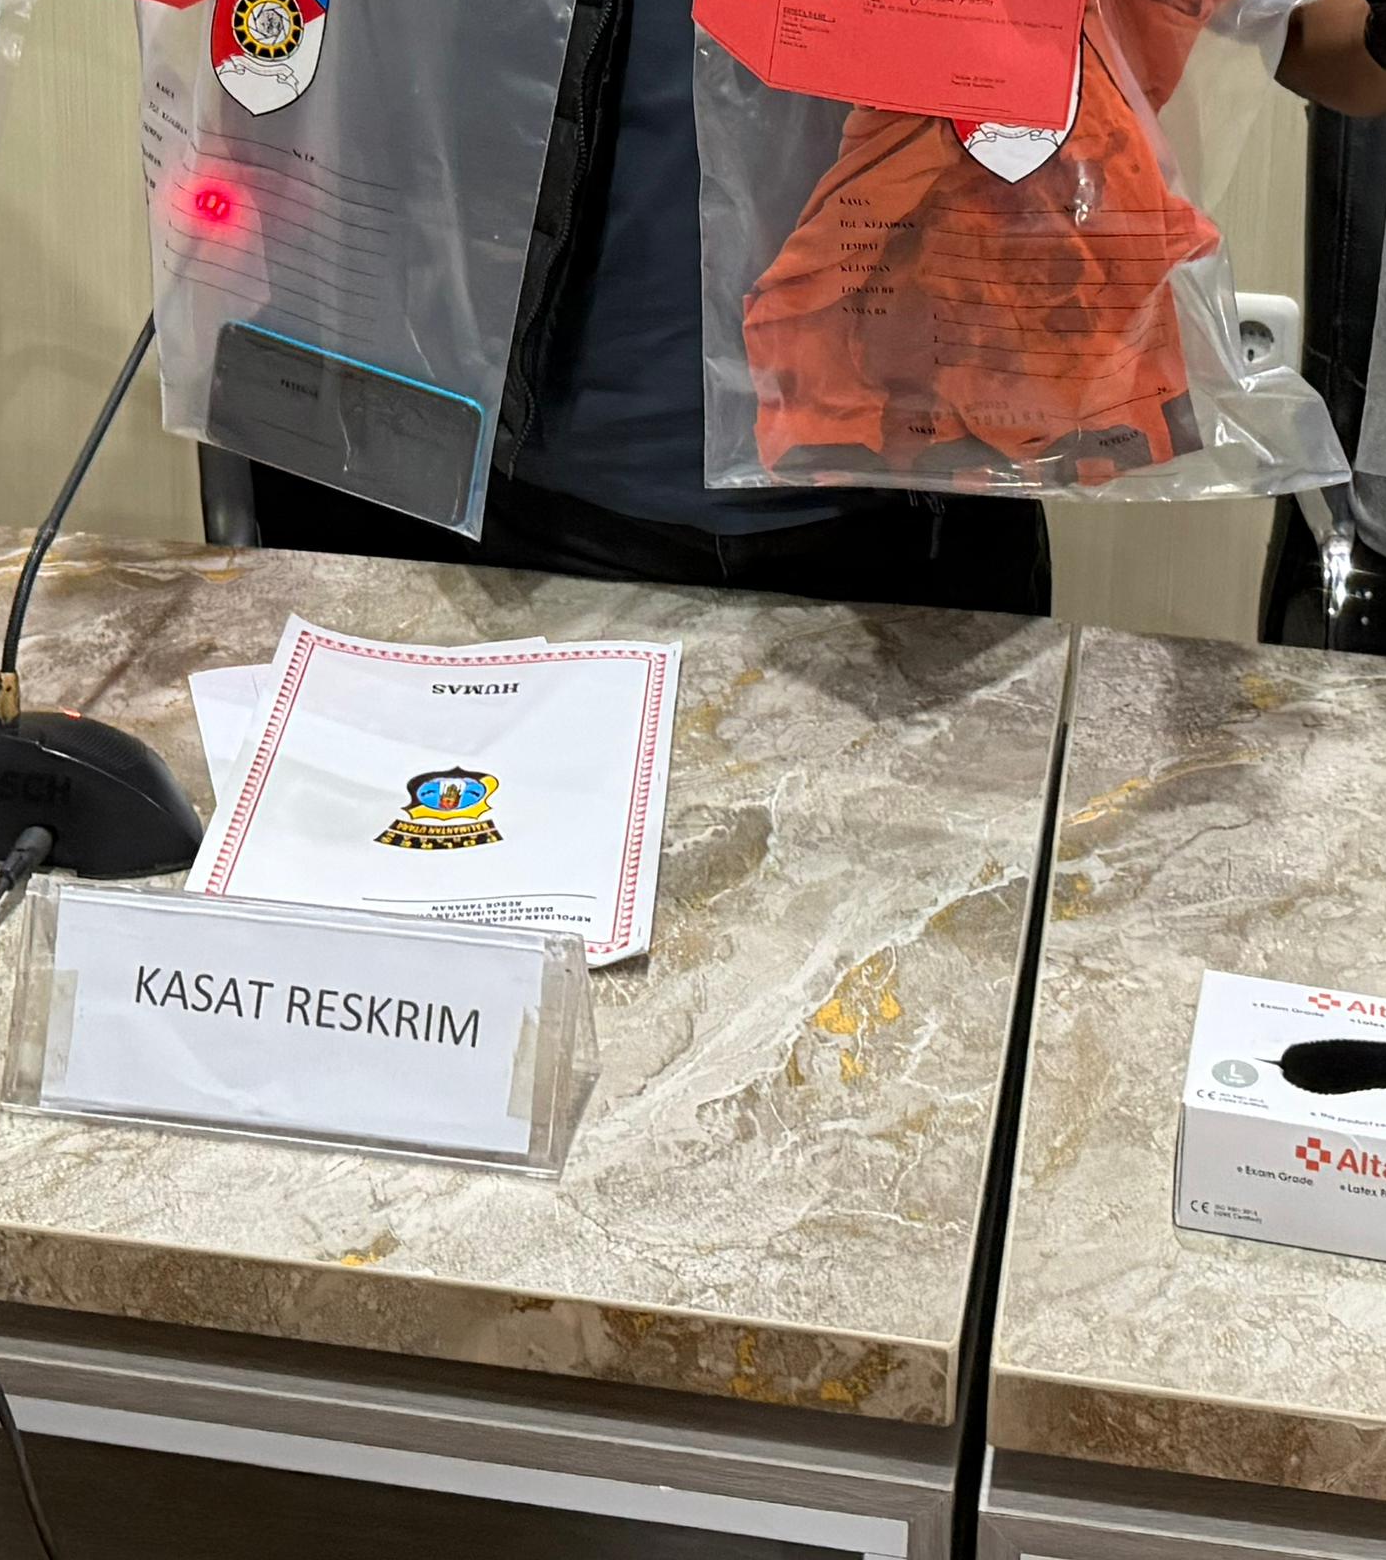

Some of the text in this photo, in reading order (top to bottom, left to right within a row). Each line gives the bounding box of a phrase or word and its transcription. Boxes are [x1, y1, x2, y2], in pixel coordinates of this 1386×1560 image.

[432, 681, 520, 695] HUMAS
[431, 903, 482, 911] TARAKAN
[525, 913, 592, 923] KEPOLISIAN
[134, 965, 482, 1048] KASAT RESKRIM
[1245, 1166, 1314, 1187] Exam Grade
[1348, 1183, 1378, 1198] Latex
